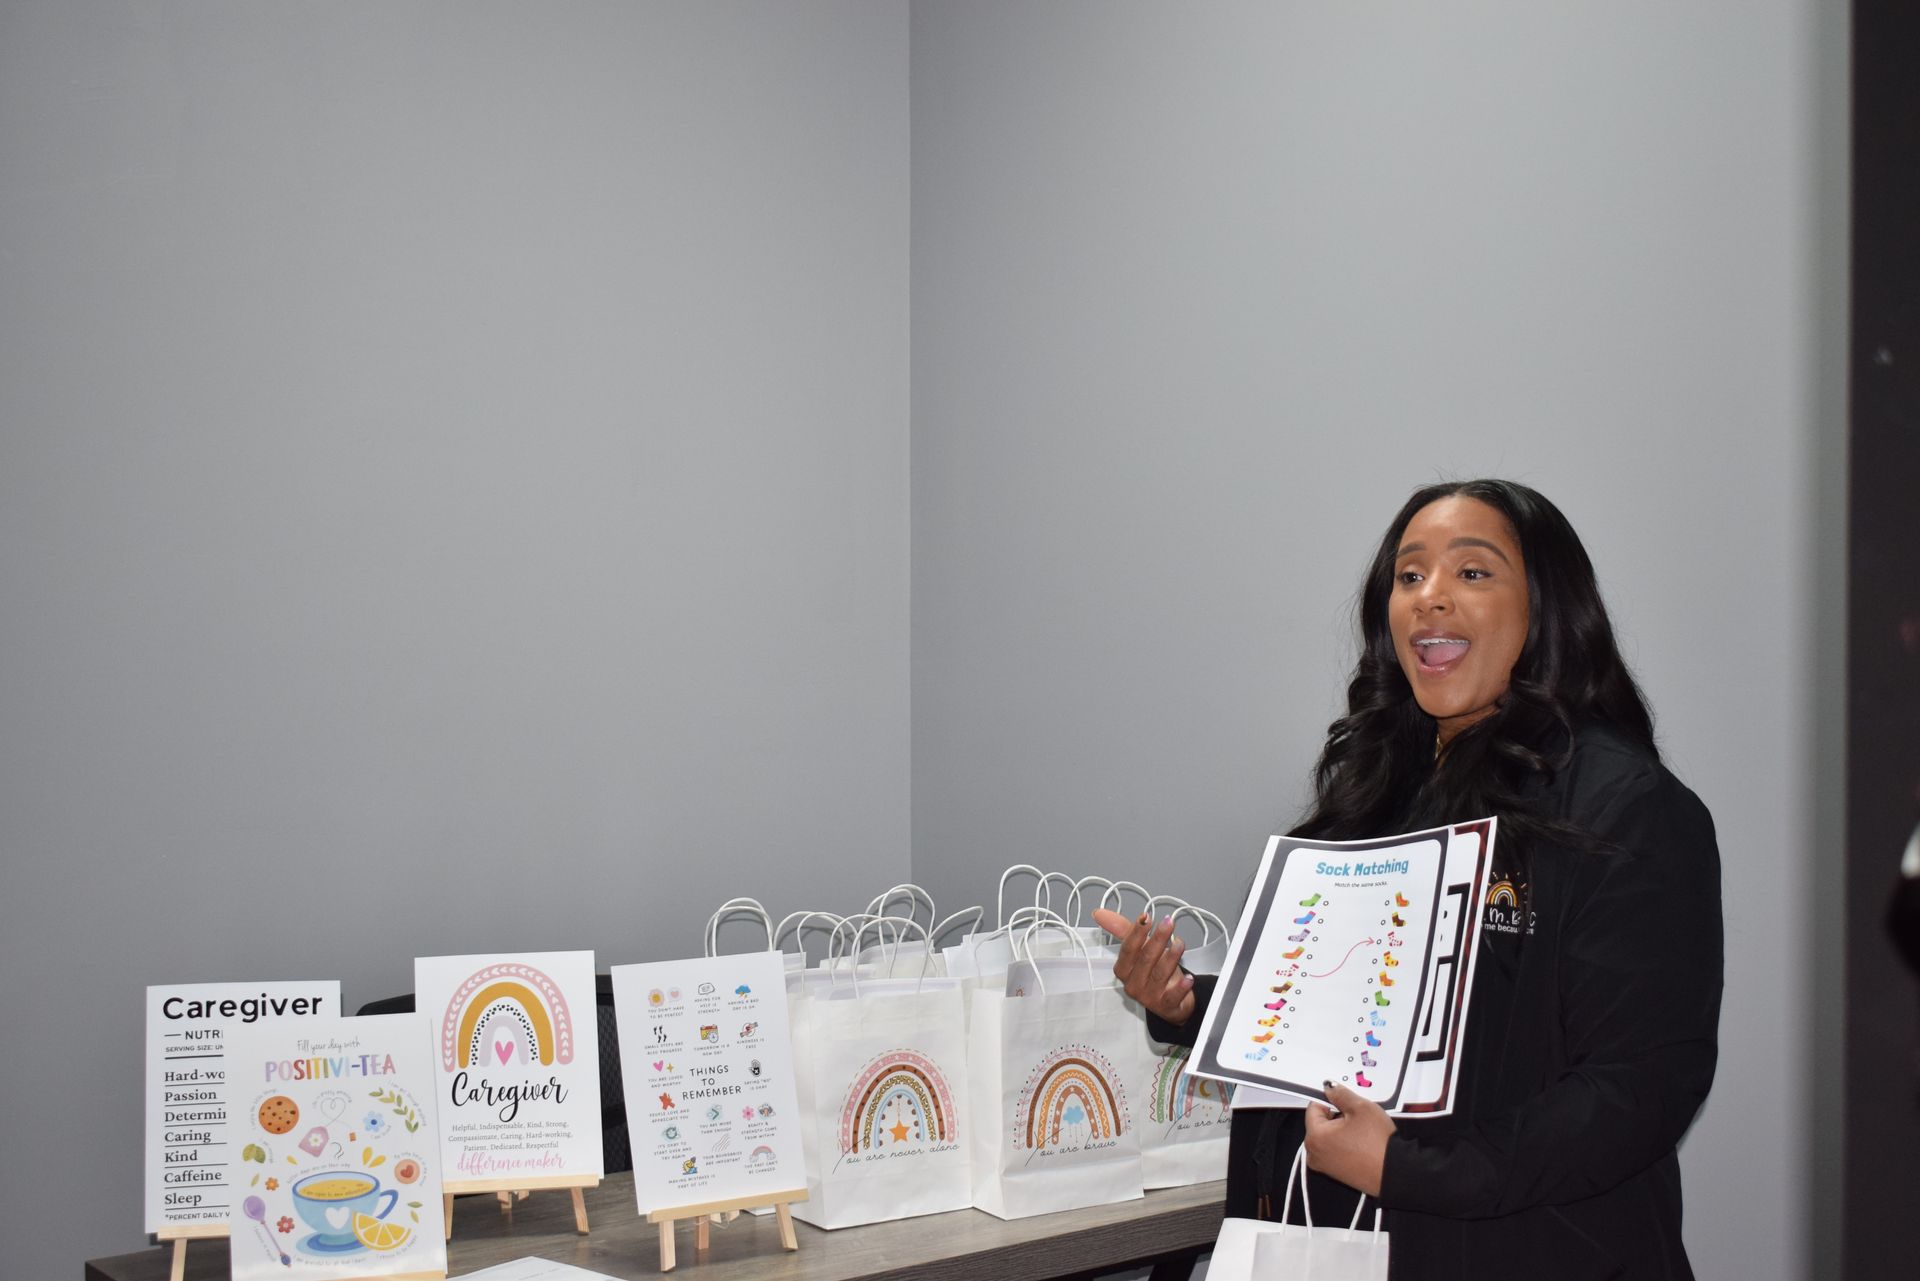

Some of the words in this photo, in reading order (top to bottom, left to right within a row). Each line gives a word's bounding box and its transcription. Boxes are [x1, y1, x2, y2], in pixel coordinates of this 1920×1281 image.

[1316, 862, 1350, 876] Sock
[1354, 859, 1409, 876] Matching
[162, 993, 323, 1023] Caregiver
[297, 1039, 310, 1052] Fill
[311, 1043, 326, 1055] your
[328, 1038, 342, 1054] day
[344, 1036, 361, 1049] with
[265, 1054, 396, 1083] POSITIVI-TEA
[689, 1064, 729, 1077] THINGS
[701, 1077, 715, 1086] TO
[165, 1089, 217, 1102] Passion
[452, 1071, 568, 1123] Caregiver
[683, 1086, 742, 1101] REMEMBER
[165, 1129, 212, 1144] Caring
[1059, 1145, 1080, 1154] are
[1084, 1131, 1118, 1151] brave
[526, 1141, 559, 1149] Respectful
[866, 1153, 886, 1161] are
[890, 1149, 925, 1158] never
[930, 1140, 960, 1153] alone
[165, 1150, 198, 1163] Kind
[457, 1151, 523, 1176] difference
[525, 1150, 565, 1169] maker
[164, 1169, 222, 1183] Caffeine
[164, 1192, 202, 1206] Sleep
